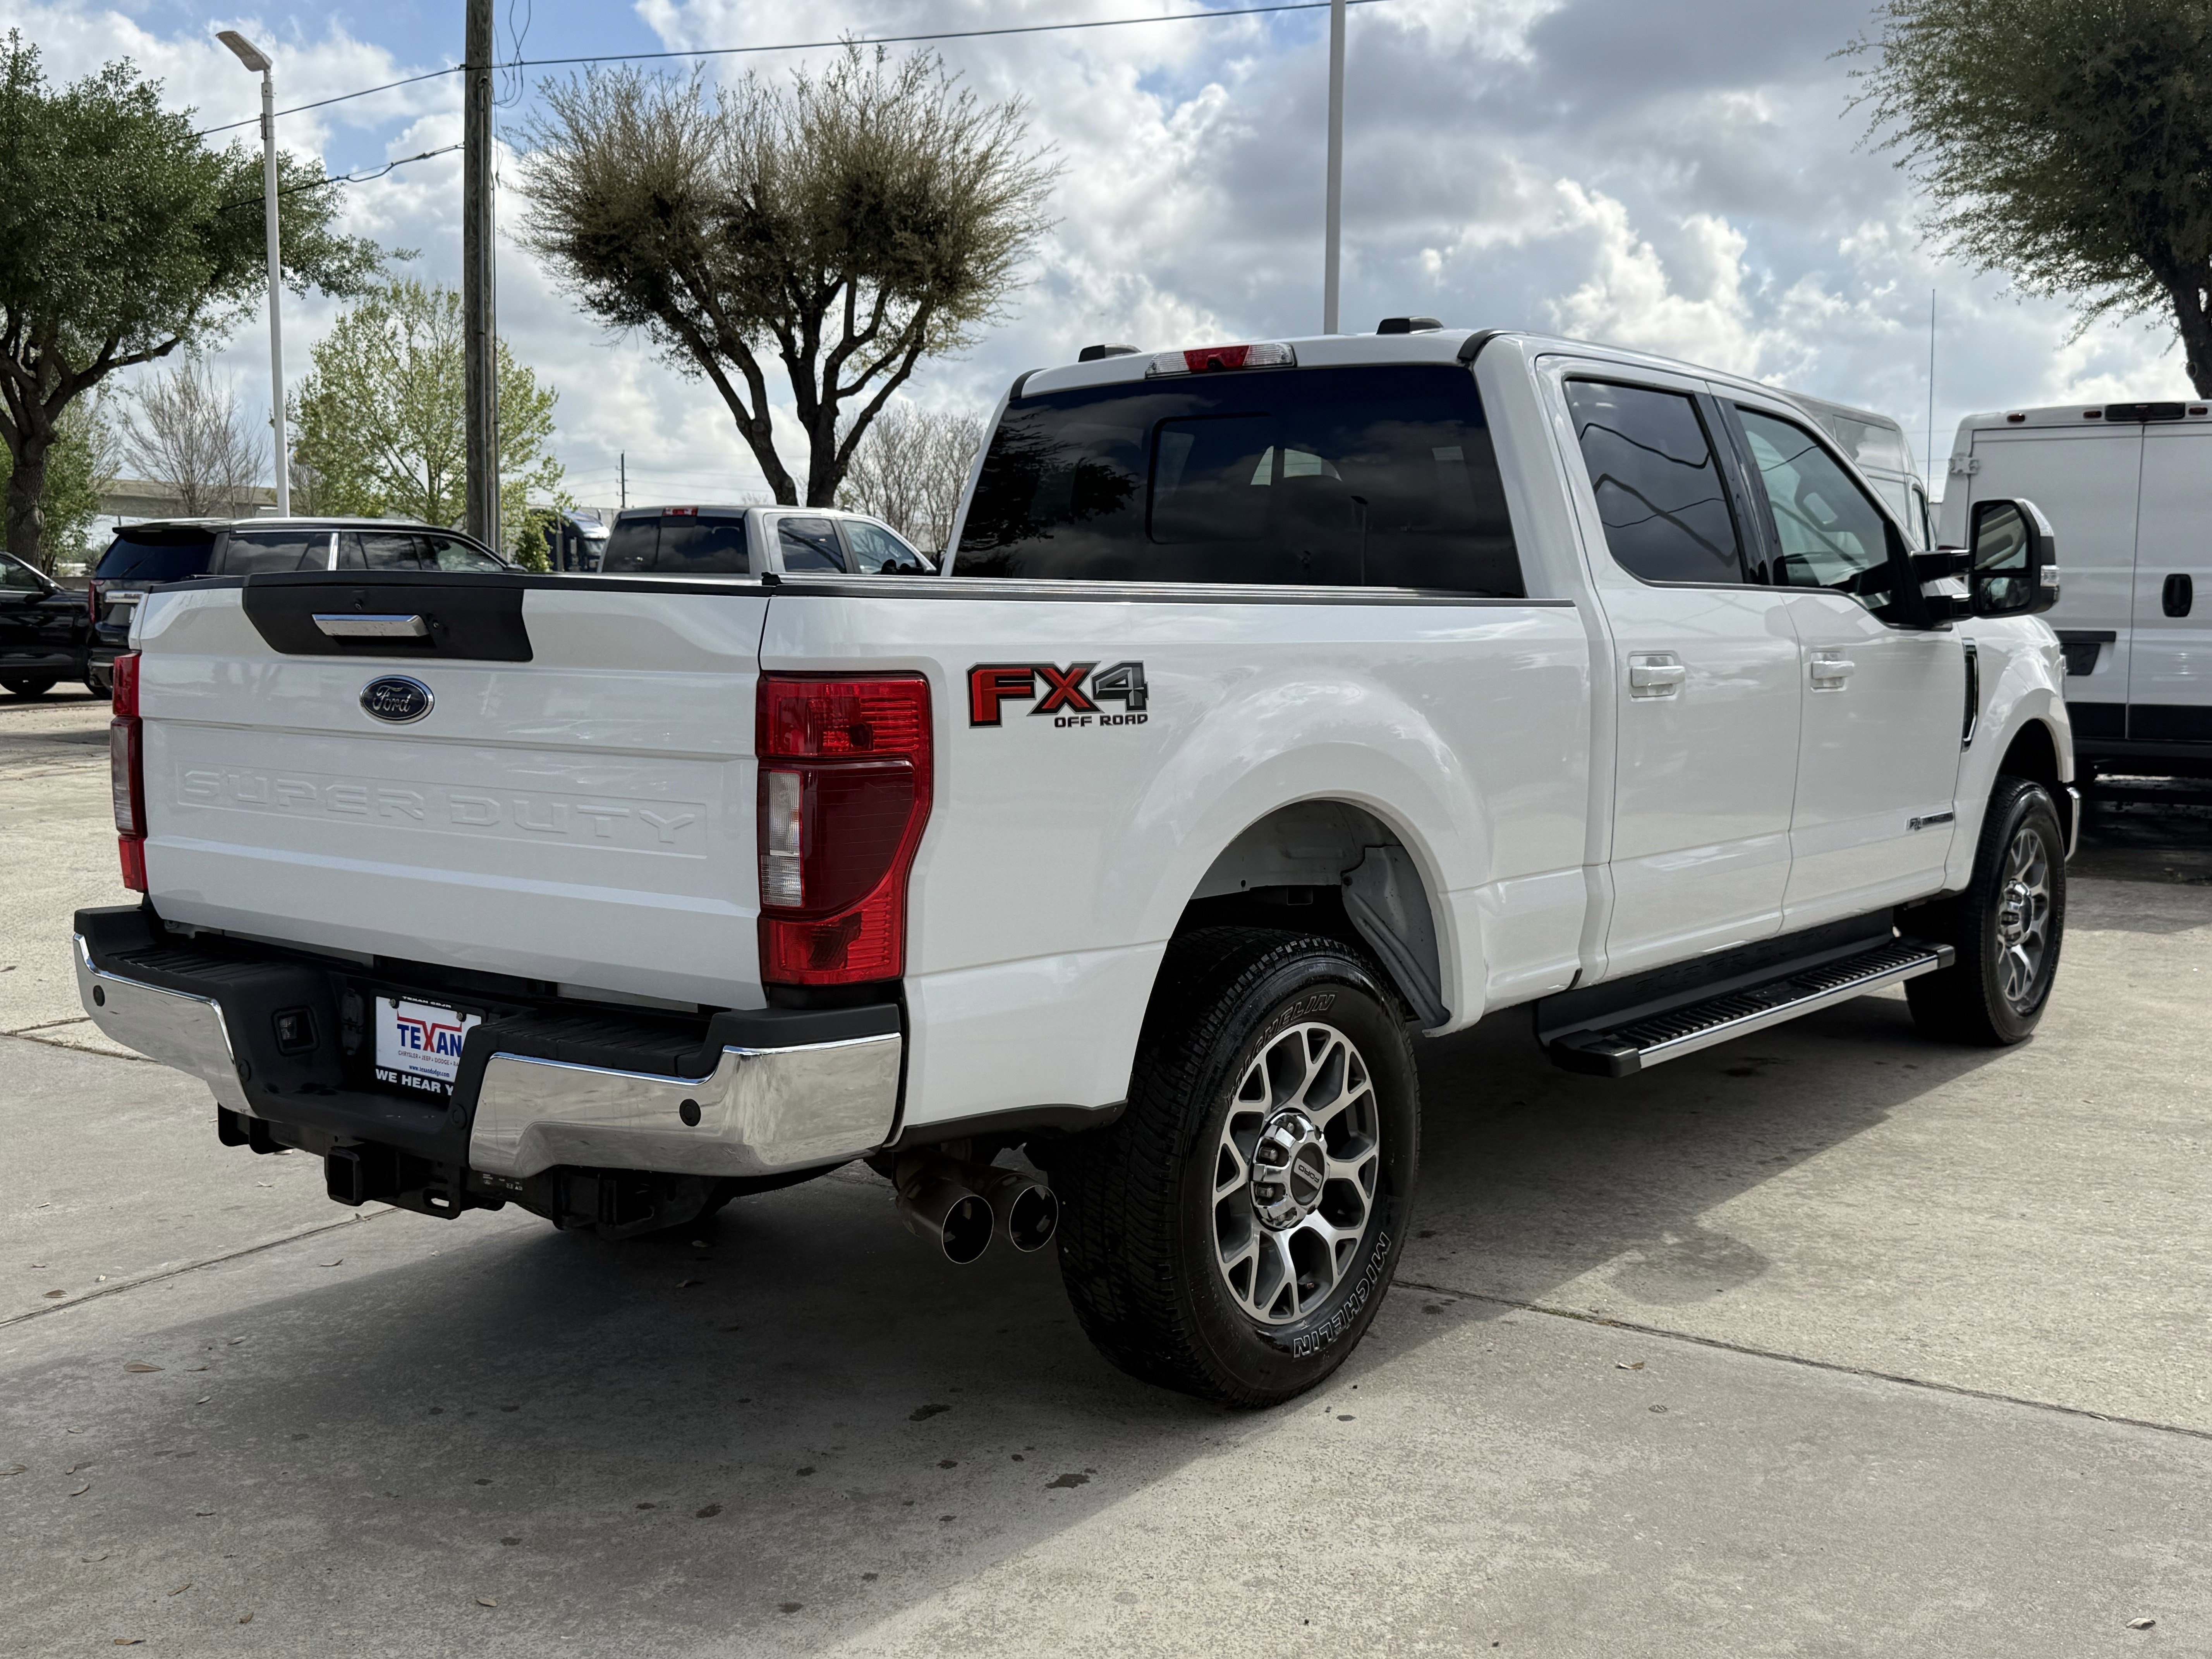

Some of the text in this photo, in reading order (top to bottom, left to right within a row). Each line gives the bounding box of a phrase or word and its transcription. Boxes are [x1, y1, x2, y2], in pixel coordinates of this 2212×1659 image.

[373, 685, 411, 712] Ford
[966, 660, 1149, 729] FX4
[1054, 713, 1148, 728] OFF ROAD
[184, 769, 696, 844] SUPER DUTY
[397, 1010, 462, 1058] TEXAN
[398, 1050, 418, 1059] CHRYSLER
[375, 1068, 397, 1083] WE
[402, 1075, 441, 1094] HEAR
[409, 1065, 450, 1078] www.texandodge.com
[1298, 1164, 1320, 1183] FORD
[1294, 1231, 1391, 1358] MICHELIN
